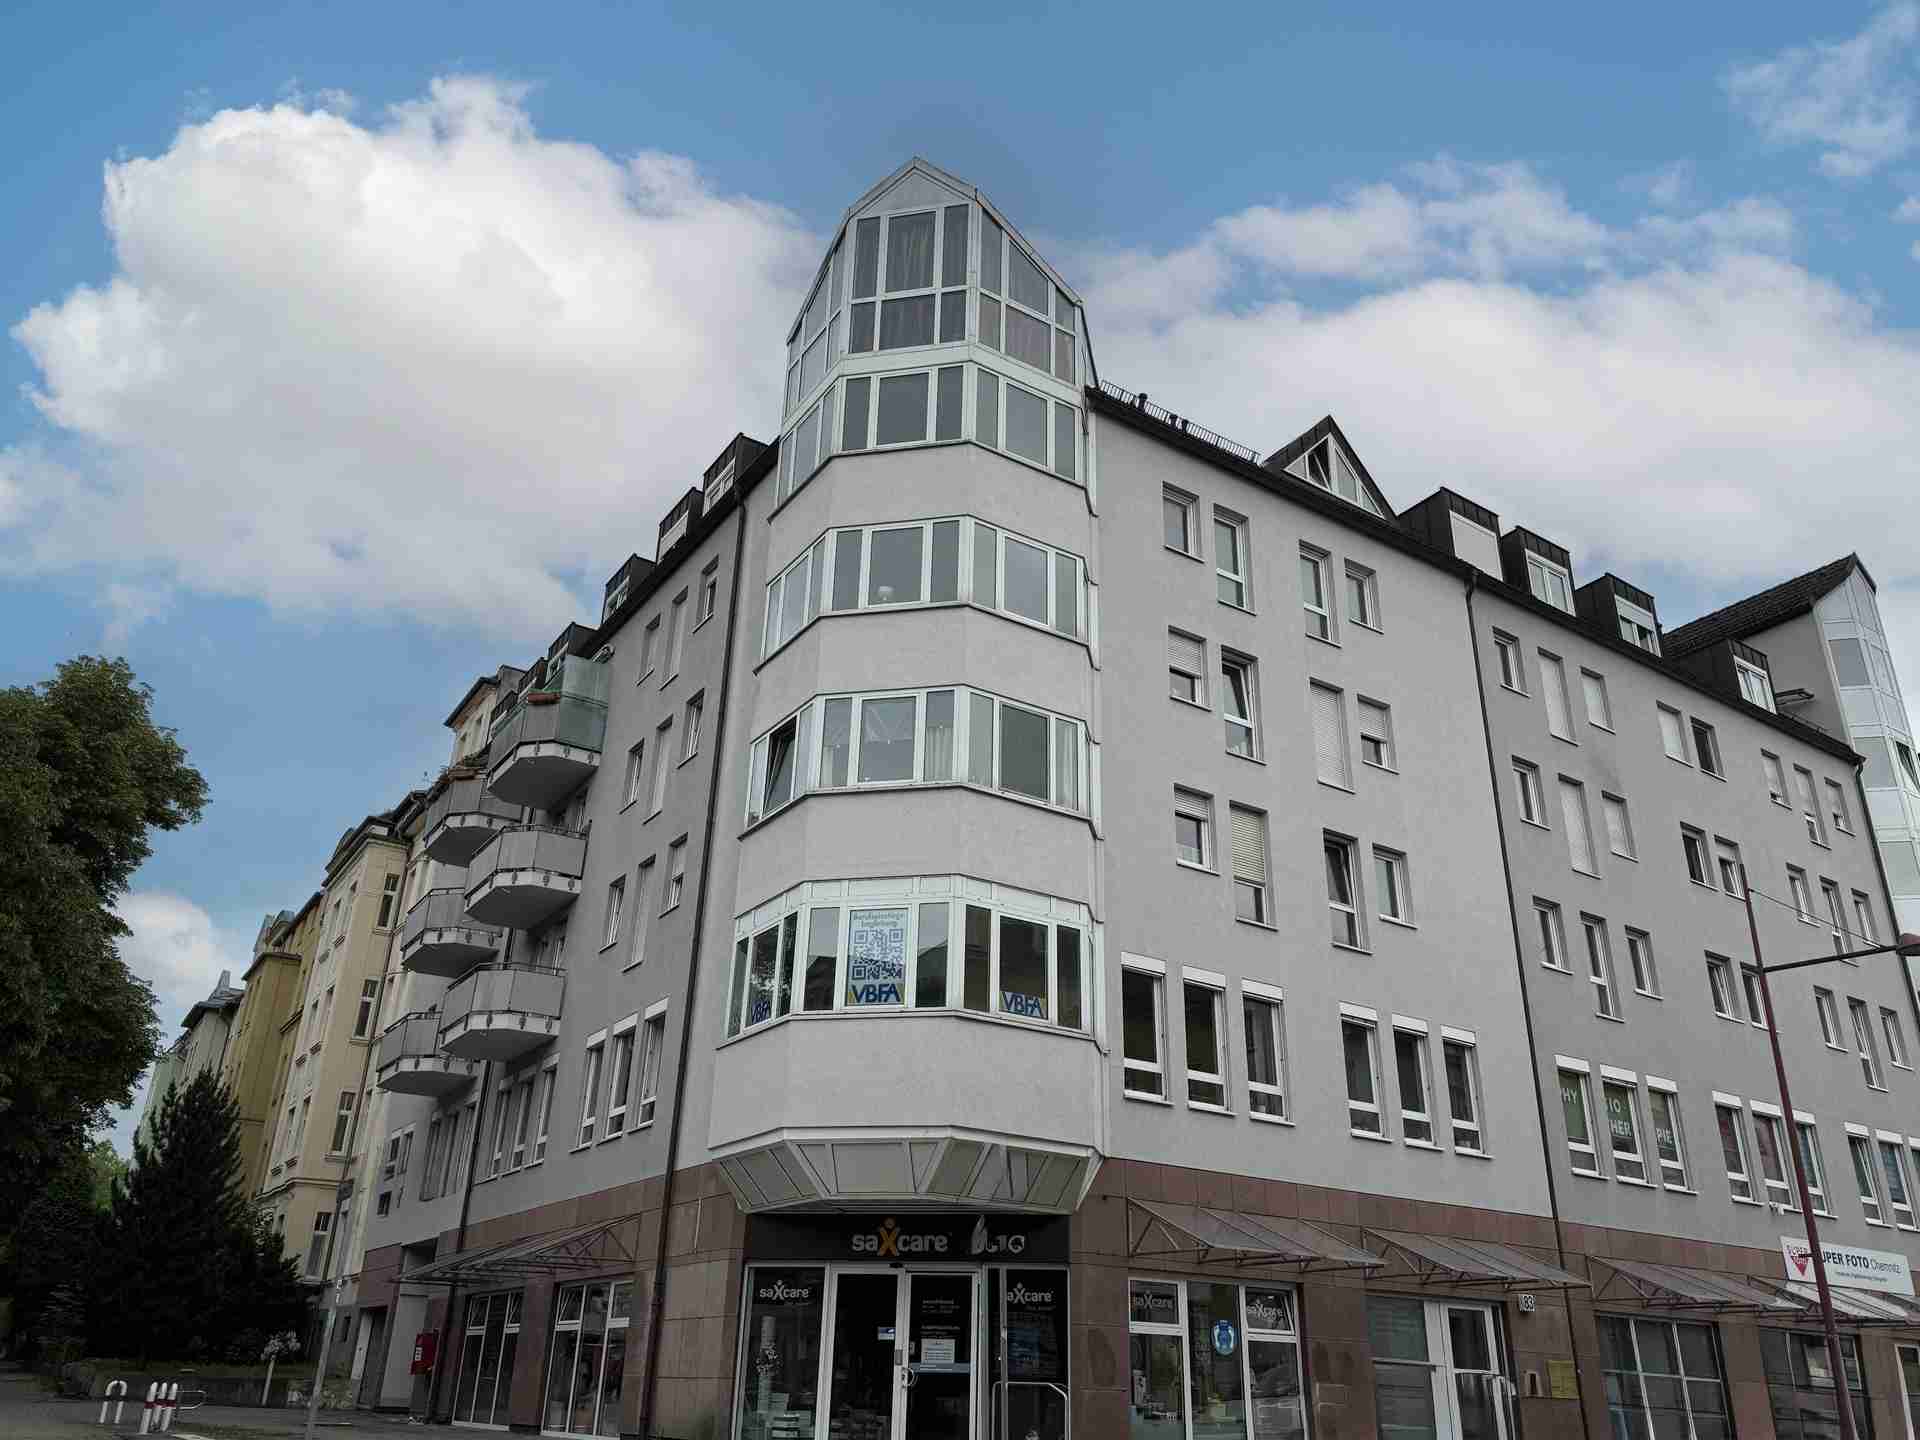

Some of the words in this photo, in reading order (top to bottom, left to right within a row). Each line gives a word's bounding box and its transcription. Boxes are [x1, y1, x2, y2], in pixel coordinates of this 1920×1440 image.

[852, 983, 901, 1003] VBFA
[1002, 991, 1043, 1018] VBFA
[1822, 1250, 1844, 1265] UPER
[1846, 1254, 1869, 1269] FOTO
[1007, 1283, 1054, 1304] aXcare
